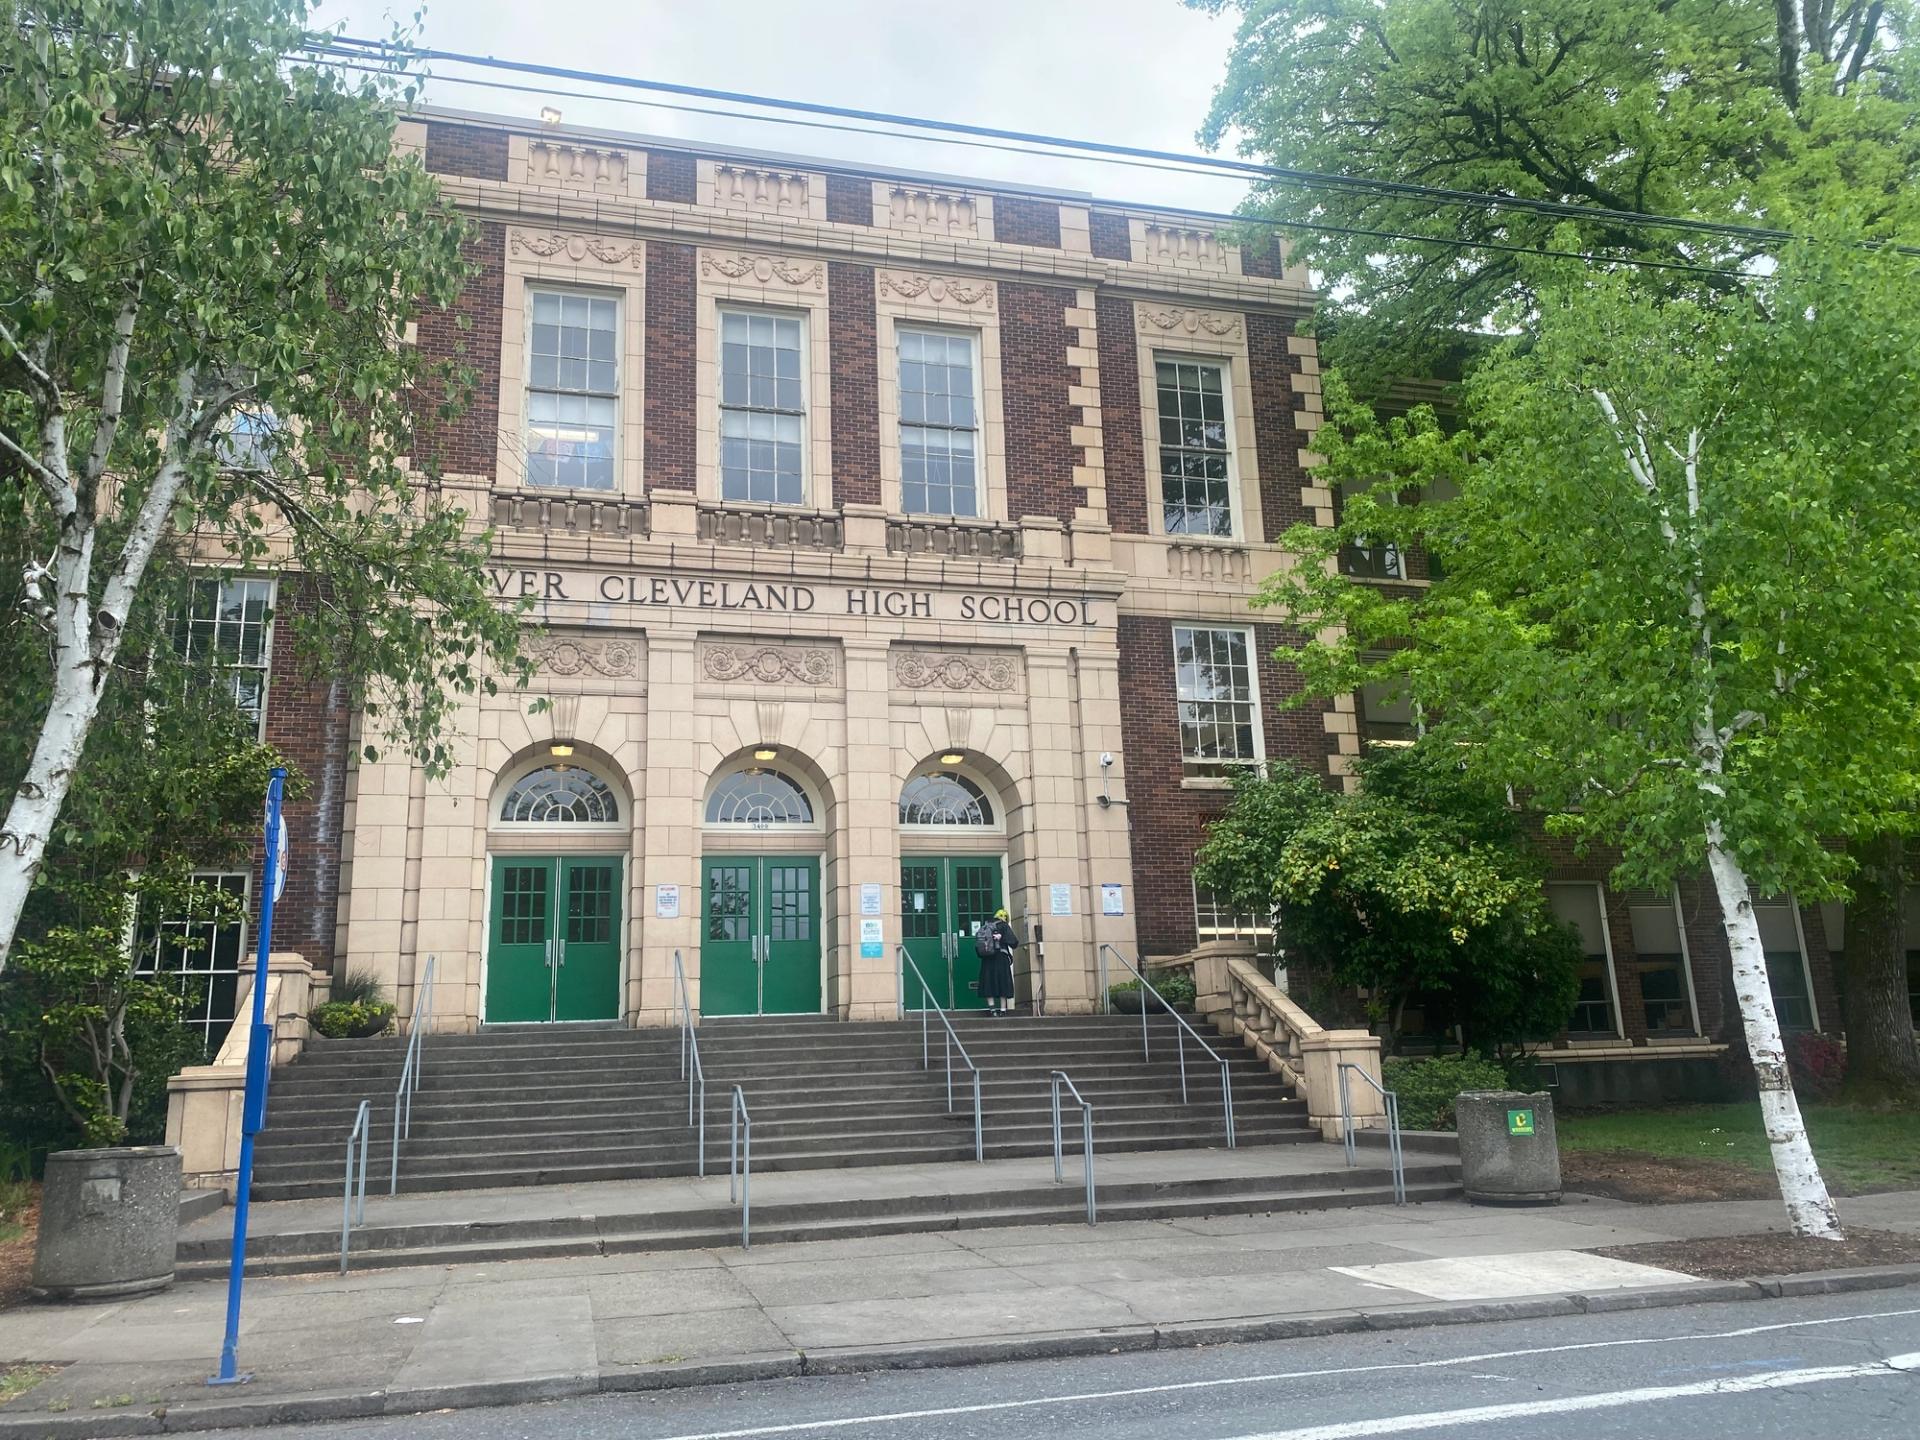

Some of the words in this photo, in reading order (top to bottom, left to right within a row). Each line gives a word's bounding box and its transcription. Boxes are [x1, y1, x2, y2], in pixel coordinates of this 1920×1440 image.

[481, 568, 570, 599] VER
[599, 575, 815, 612] CLEVELAND
[846, 588, 932, 617] HIGH
[960, 595, 1098, 626] SCHOOL
